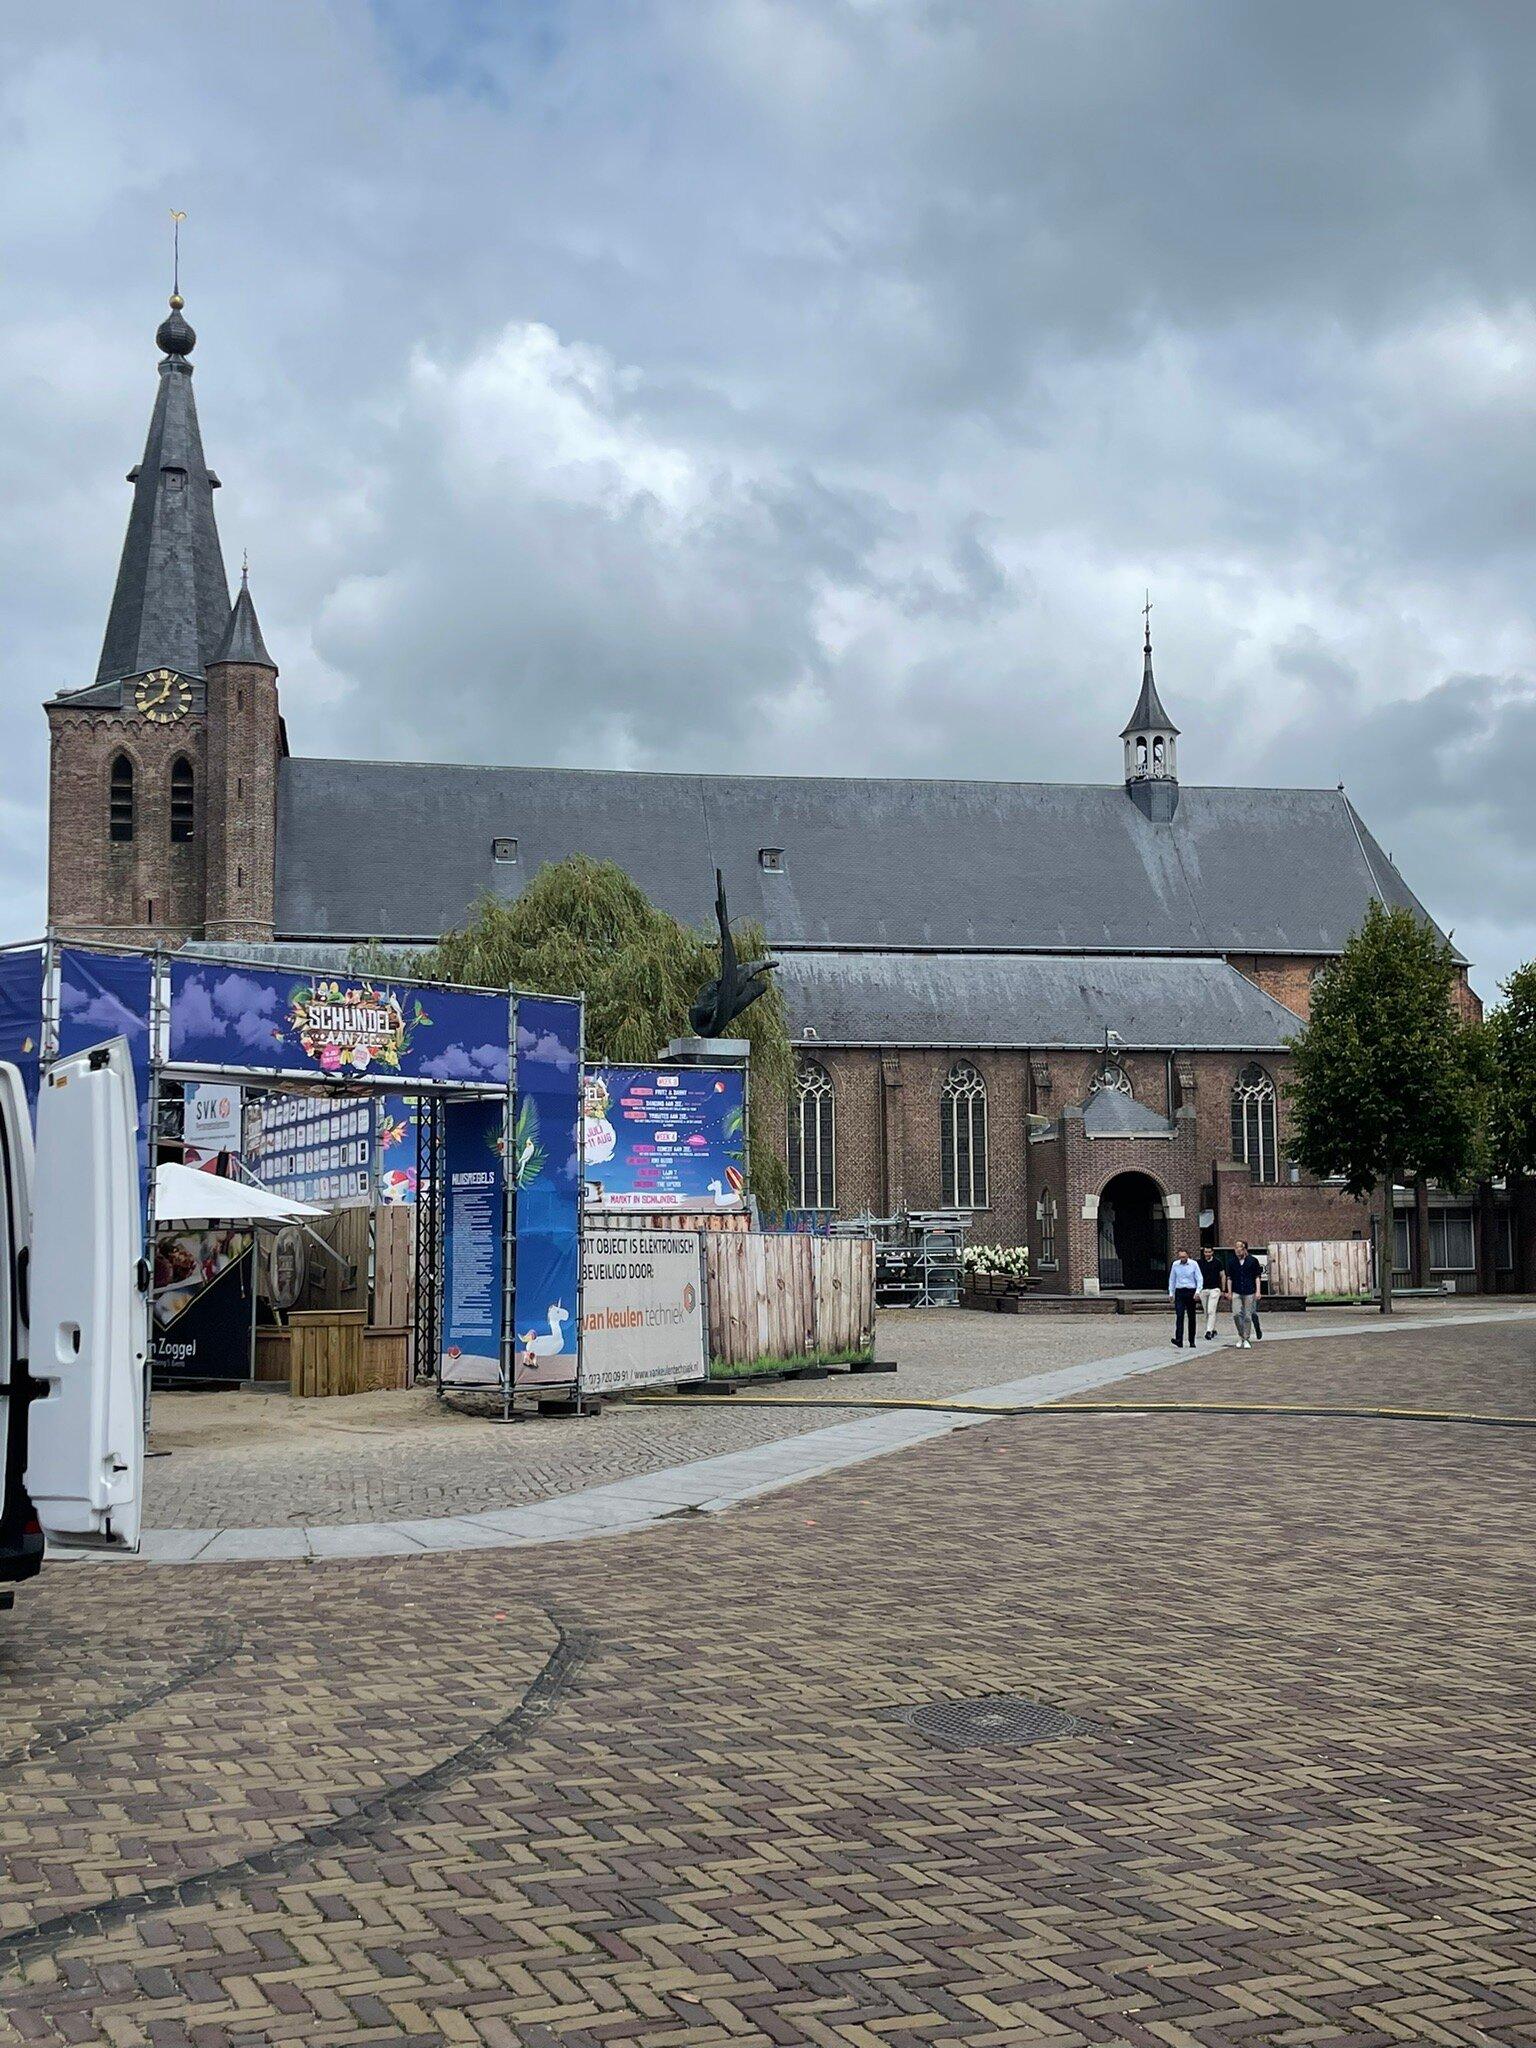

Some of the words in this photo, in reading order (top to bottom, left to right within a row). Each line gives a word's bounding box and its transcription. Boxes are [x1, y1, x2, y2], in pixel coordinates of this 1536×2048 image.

[318, 1031, 353, 1046] AAN
[354, 1032, 382, 1047] ZEE
[196, 1099, 217, 1120] SVK
[597, 1132, 612, 1145] AUG
[582, 1239, 595, 1254] DIT
[597, 1239, 627, 1255] OBJECT
[630, 1239, 638, 1254] IS
[640, 1239, 694, 1255] ELEKTRONISCH
[582, 1264, 627, 1280] BEVEILIGD
[629, 1263, 654, 1279] DOOR:
[581, 1313, 605, 1331] van
[607, 1306, 643, 1328] keulen
[645, 1303, 685, 1327] techniek
[159, 1338, 196, 1360] Zoggel
